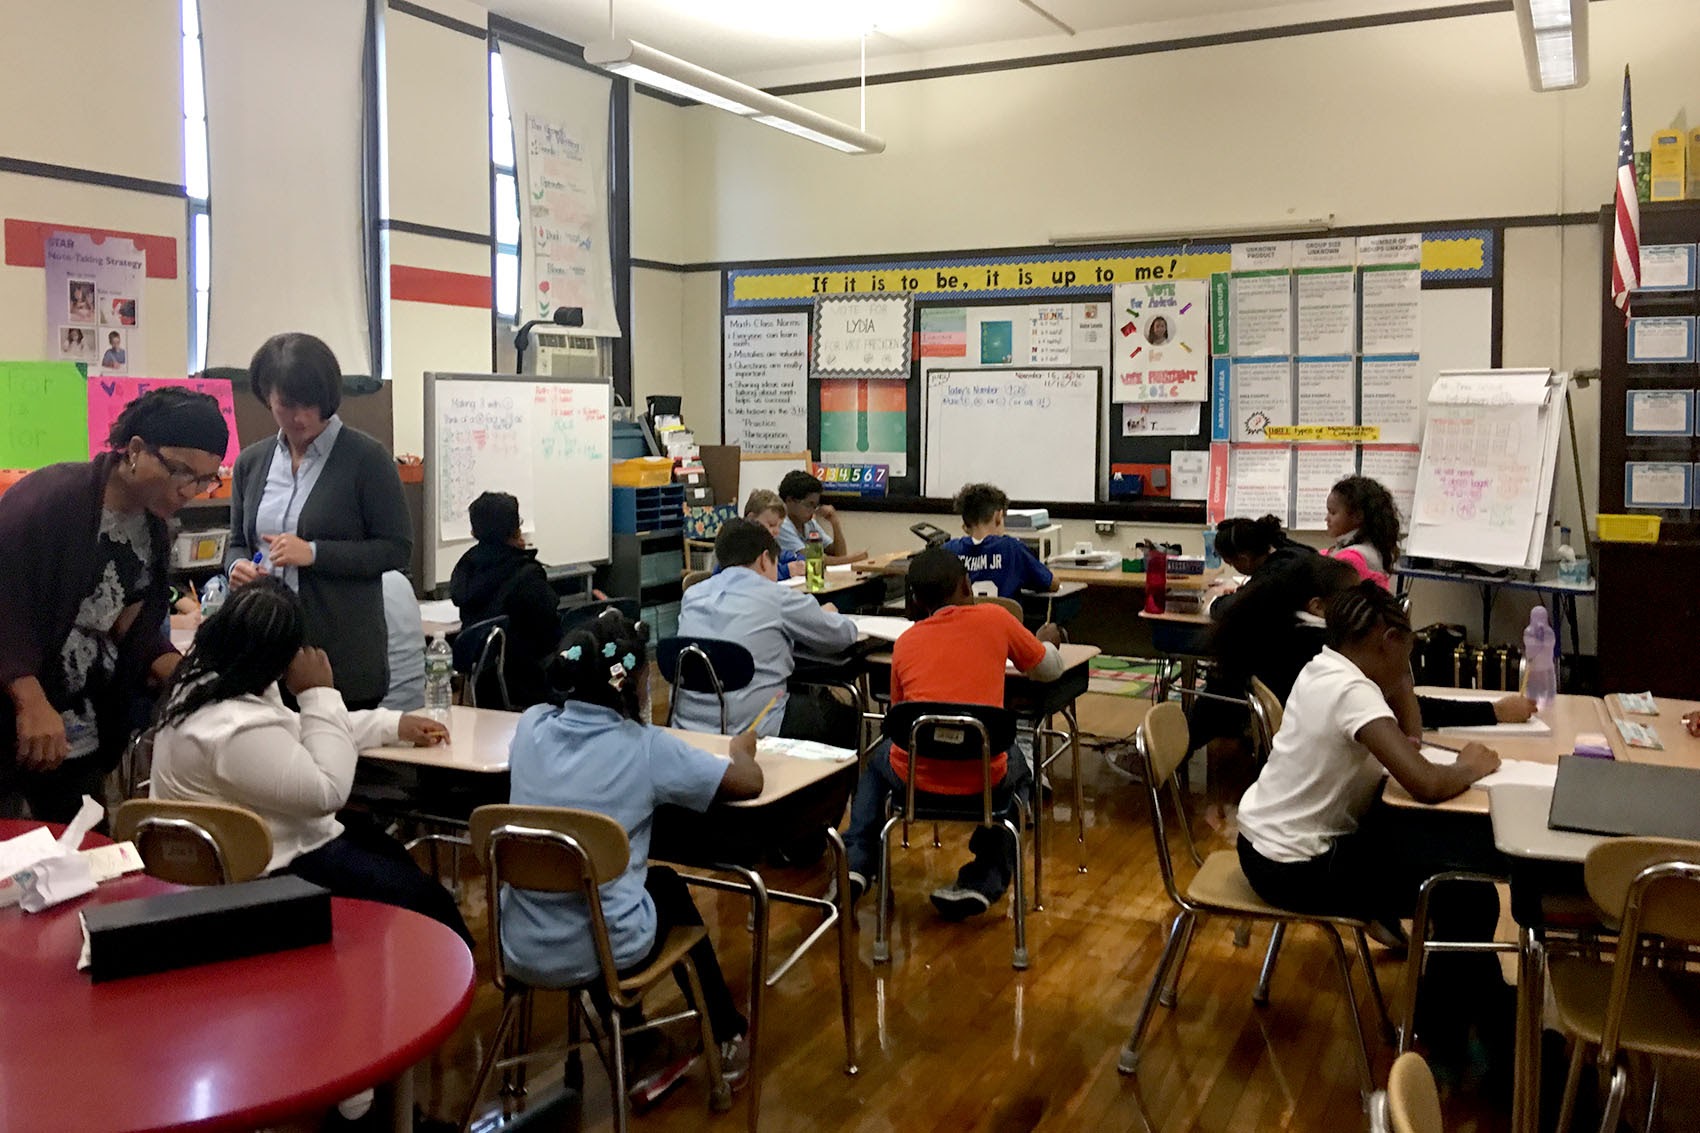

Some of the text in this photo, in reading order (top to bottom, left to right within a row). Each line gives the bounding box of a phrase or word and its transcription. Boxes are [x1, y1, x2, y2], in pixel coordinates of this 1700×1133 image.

[105, 256, 142, 269] Strategy
[812, 259, 1177, 293] If it is to be, it is up to me!
[846, 318, 875, 334] LYDIA
[816, 467, 885, 482] 2 3 4 5 6 7
[990, 554, 1002, 569] JR
